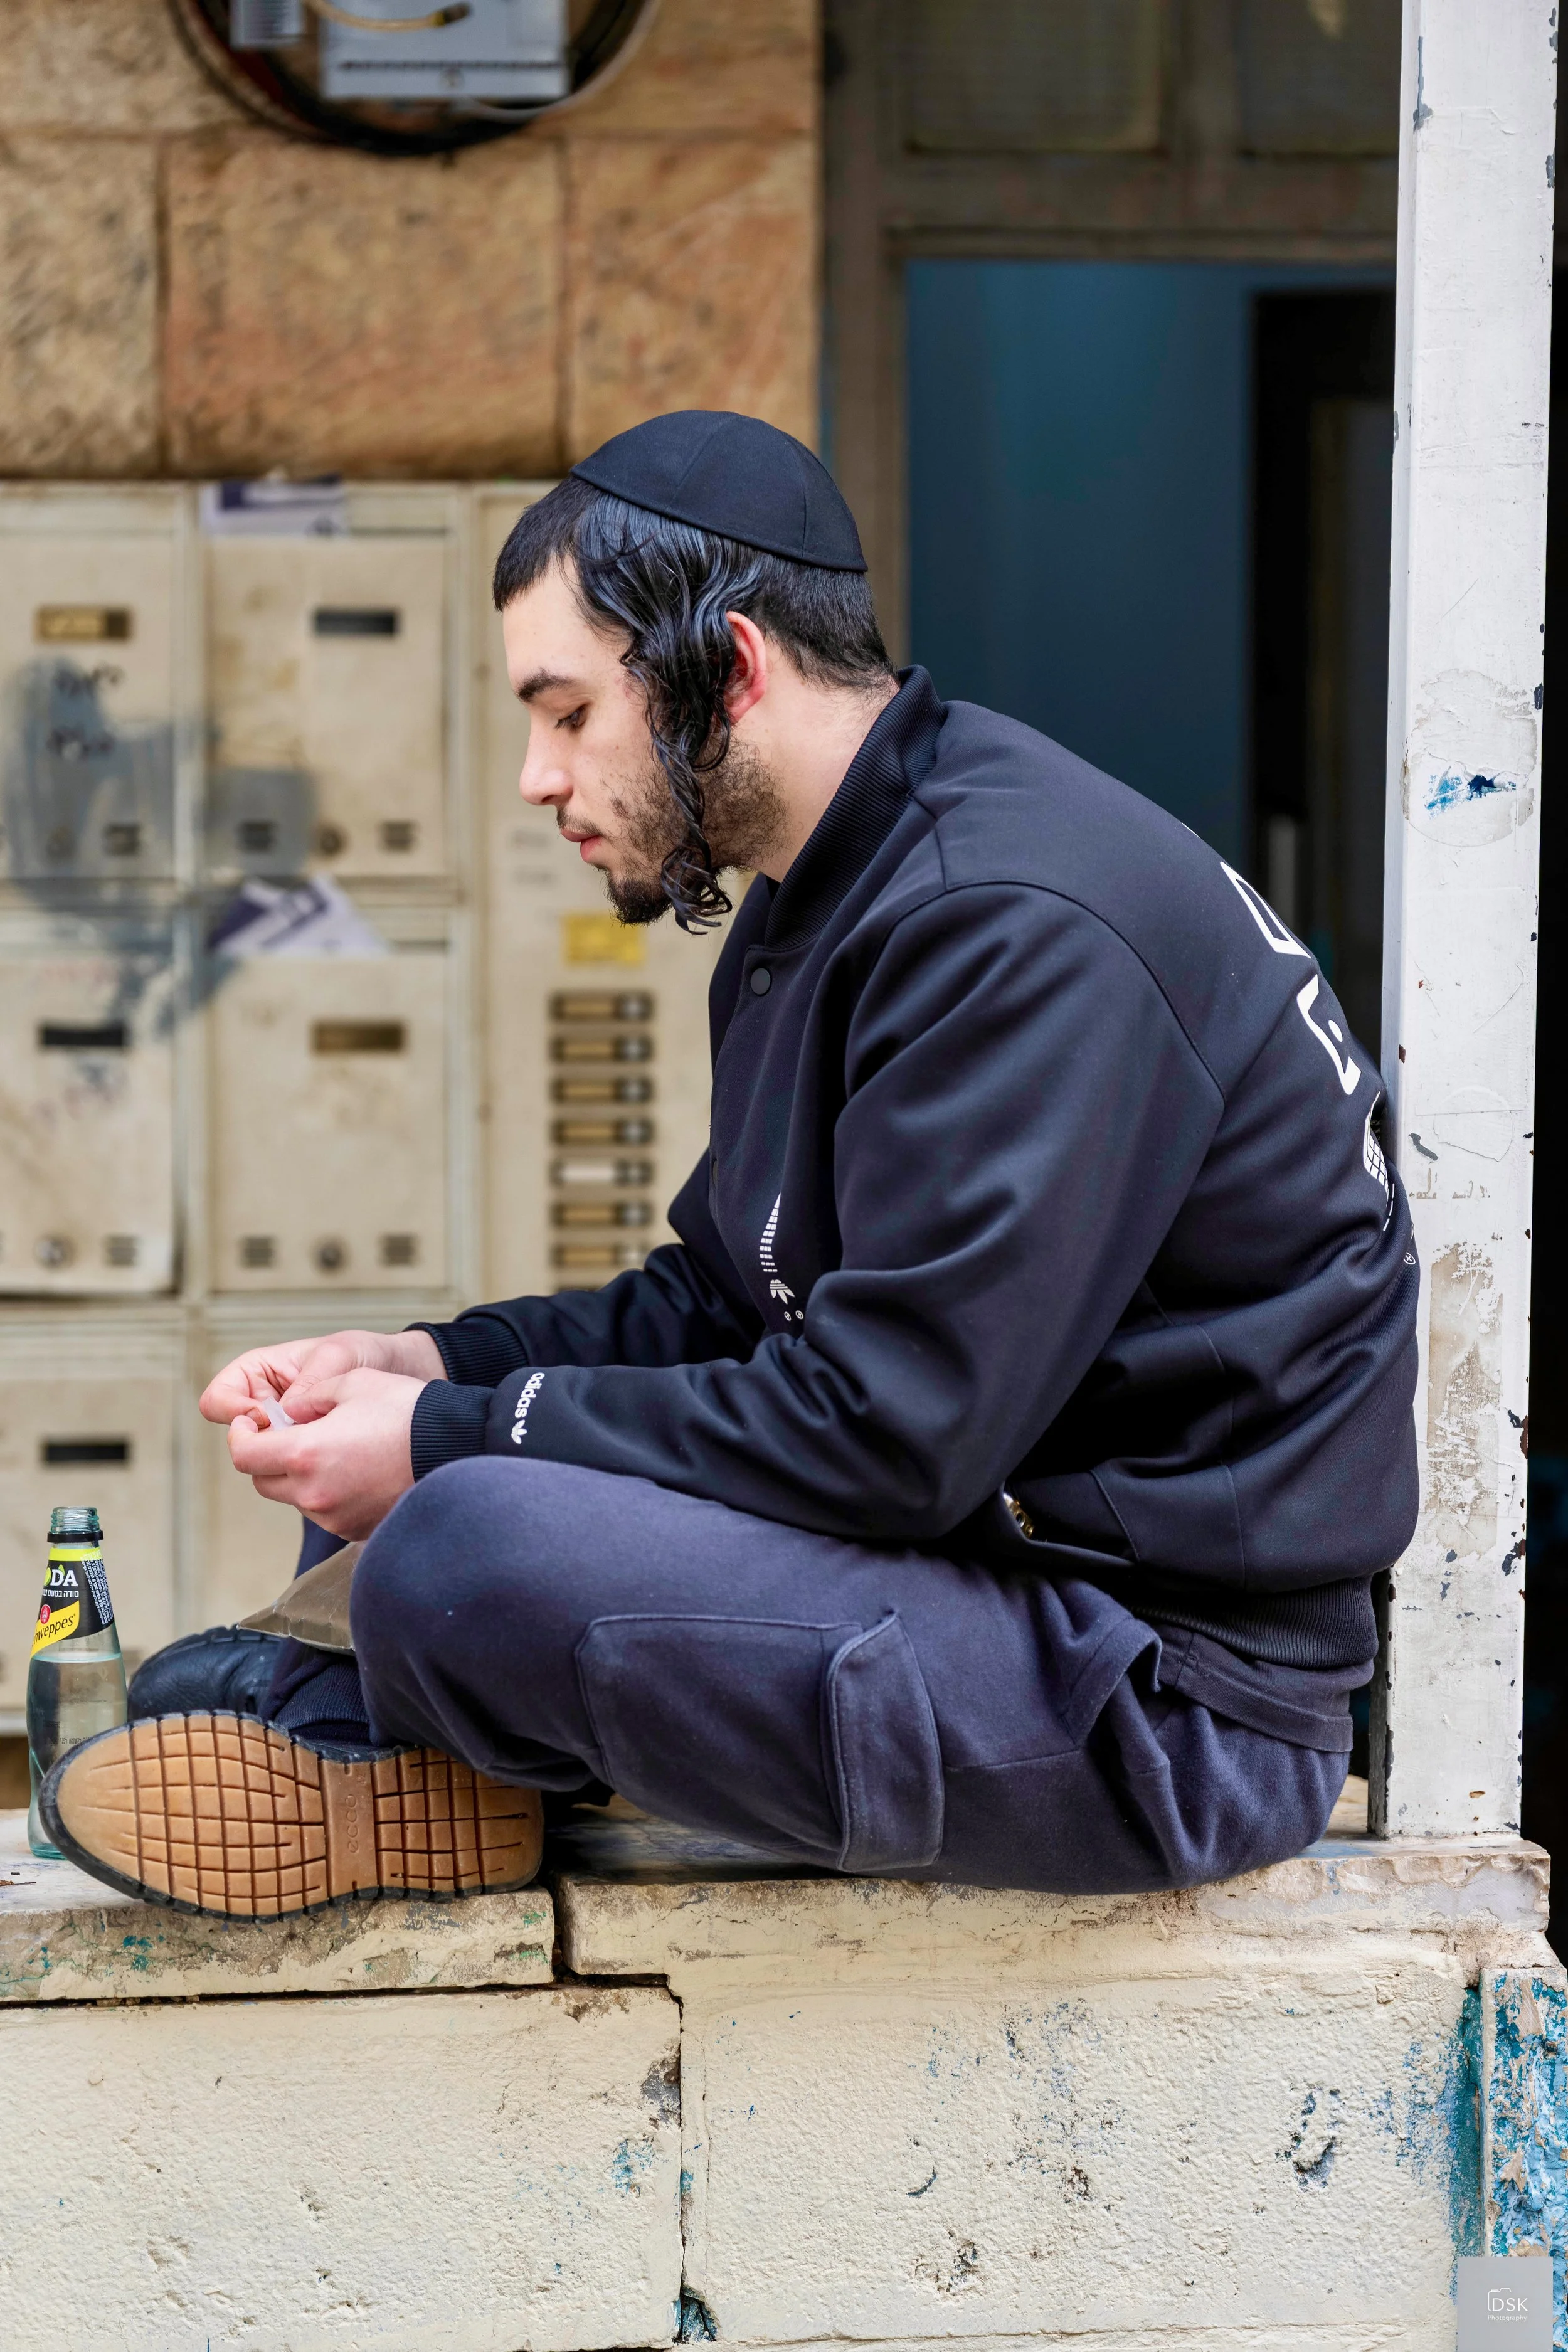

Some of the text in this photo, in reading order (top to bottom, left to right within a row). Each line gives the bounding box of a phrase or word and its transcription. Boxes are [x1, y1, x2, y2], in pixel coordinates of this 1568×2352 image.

[514, 1372, 545, 1419] adidas
[48, 1589, 63, 1597] בטעם
[63, 1590, 79, 1598] סודה
[34, 1616, 73, 1644] hweppes
[346, 1794, 359, 1853] ecco
